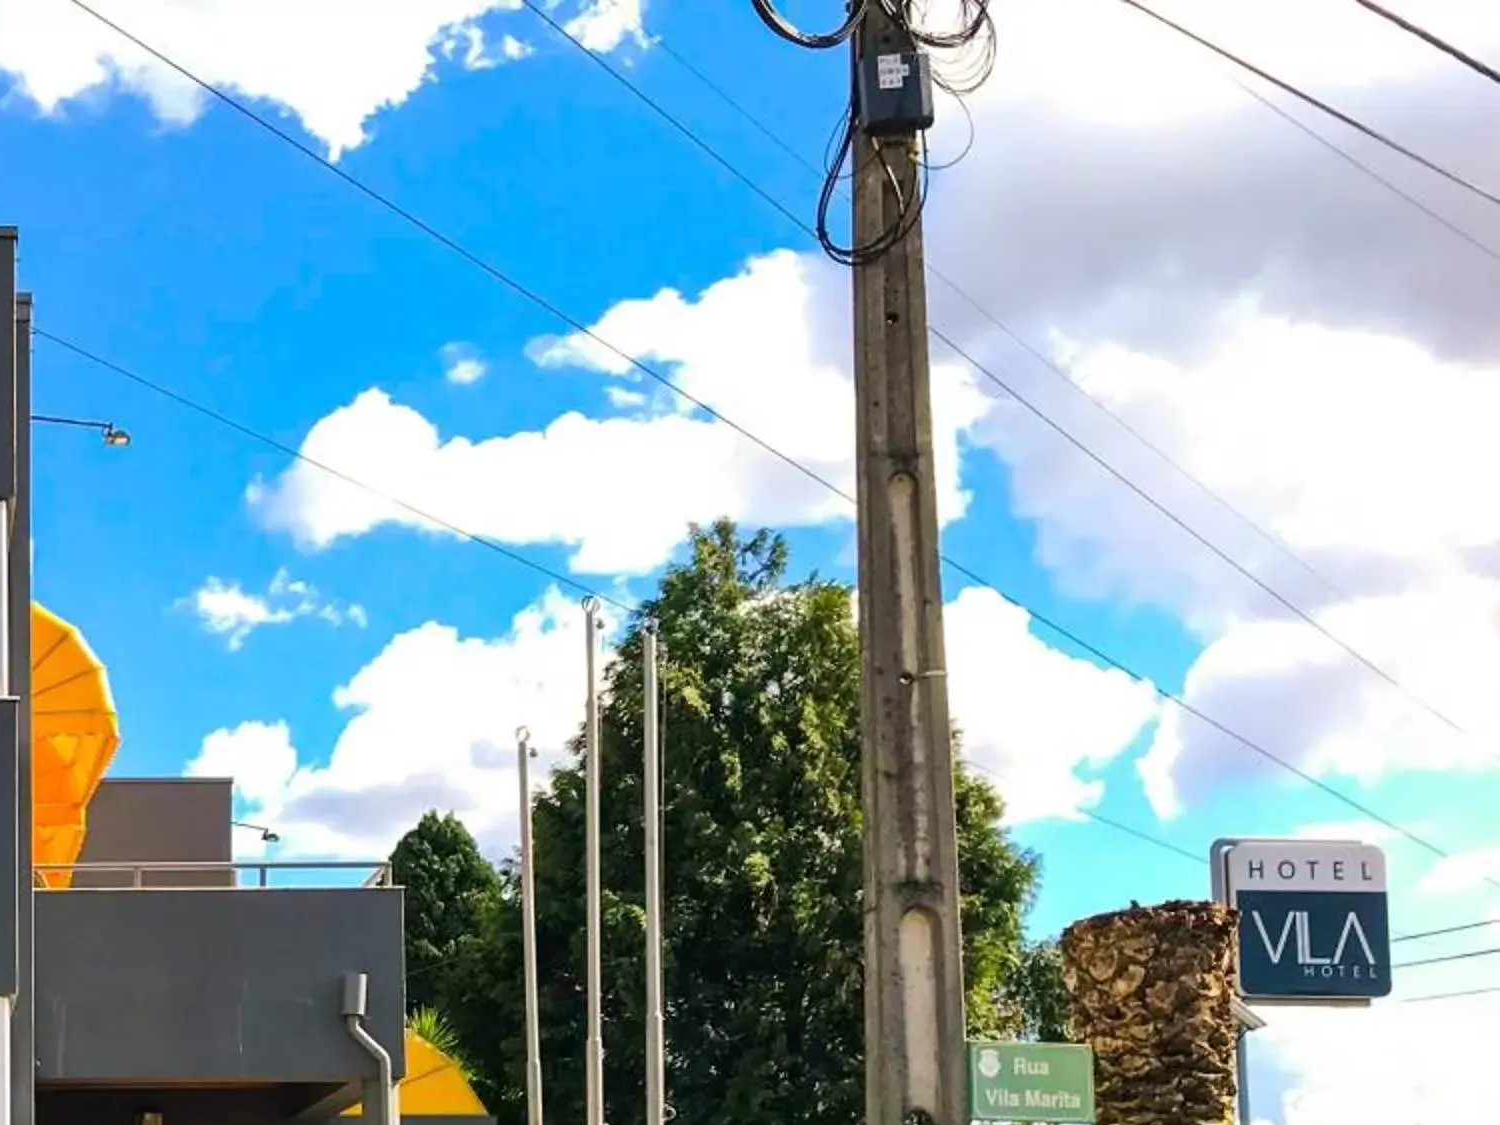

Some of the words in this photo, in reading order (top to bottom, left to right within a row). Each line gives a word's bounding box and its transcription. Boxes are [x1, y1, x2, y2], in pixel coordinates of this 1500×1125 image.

[1248, 859, 1373, 880] HOTEL
[1251, 910, 1376, 965] VILA
[1304, 965, 1377, 978] HOTEL
[1014, 1057, 1050, 1075] Rua
[985, 1088, 1020, 1107] Vila
[1025, 1089, 1082, 1109] Marita
